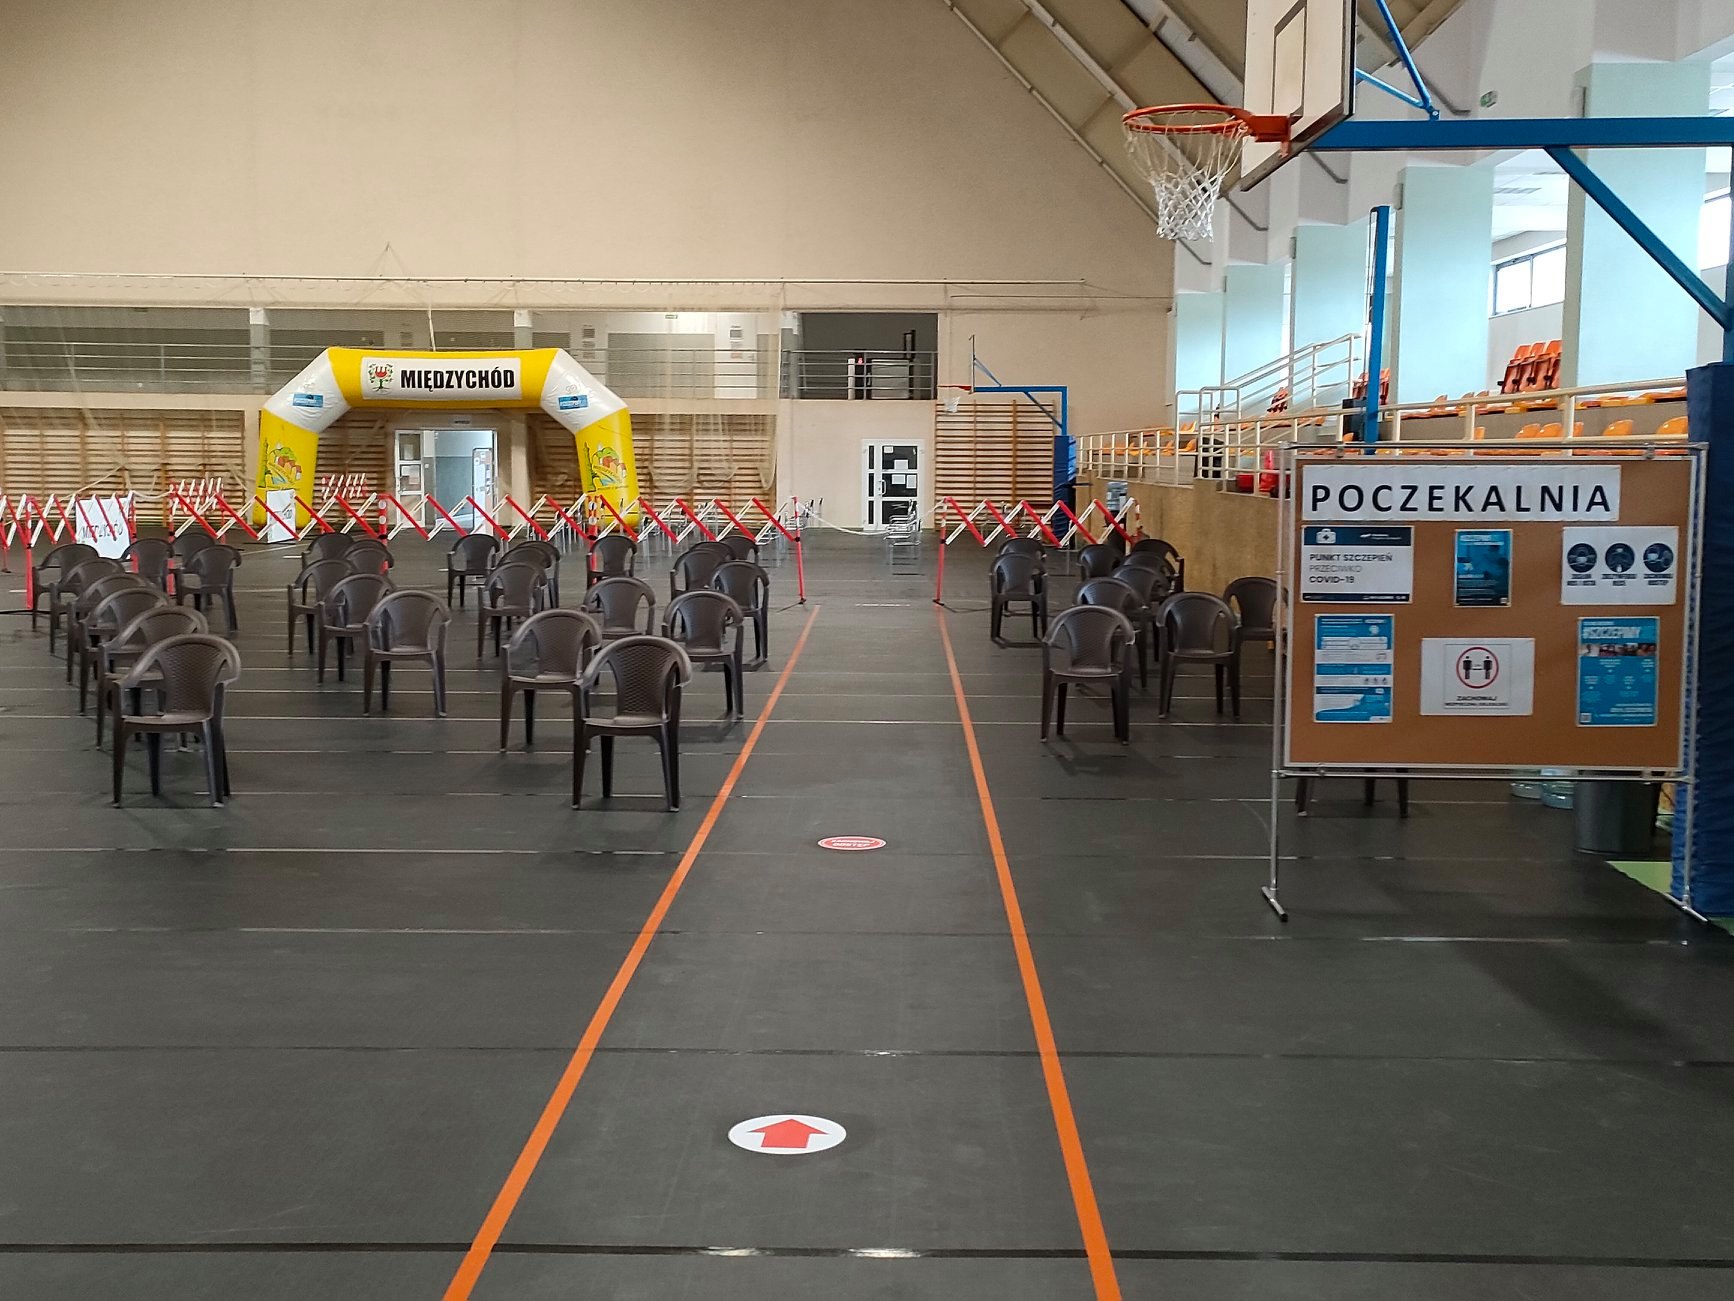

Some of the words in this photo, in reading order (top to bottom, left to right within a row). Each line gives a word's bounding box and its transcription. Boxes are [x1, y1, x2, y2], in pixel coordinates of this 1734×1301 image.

[400, 366, 515, 392] MIĘDZYCHÓD
[1311, 484, 1611, 513] POCZEKALNIA
[1309, 553, 1341, 562] PUNKT
[1343, 551, 1393, 562] SZCZEPIEŃ
[1309, 564, 1362, 573] PRZECIWKO
[1309, 575, 1355, 584] COVID-19
